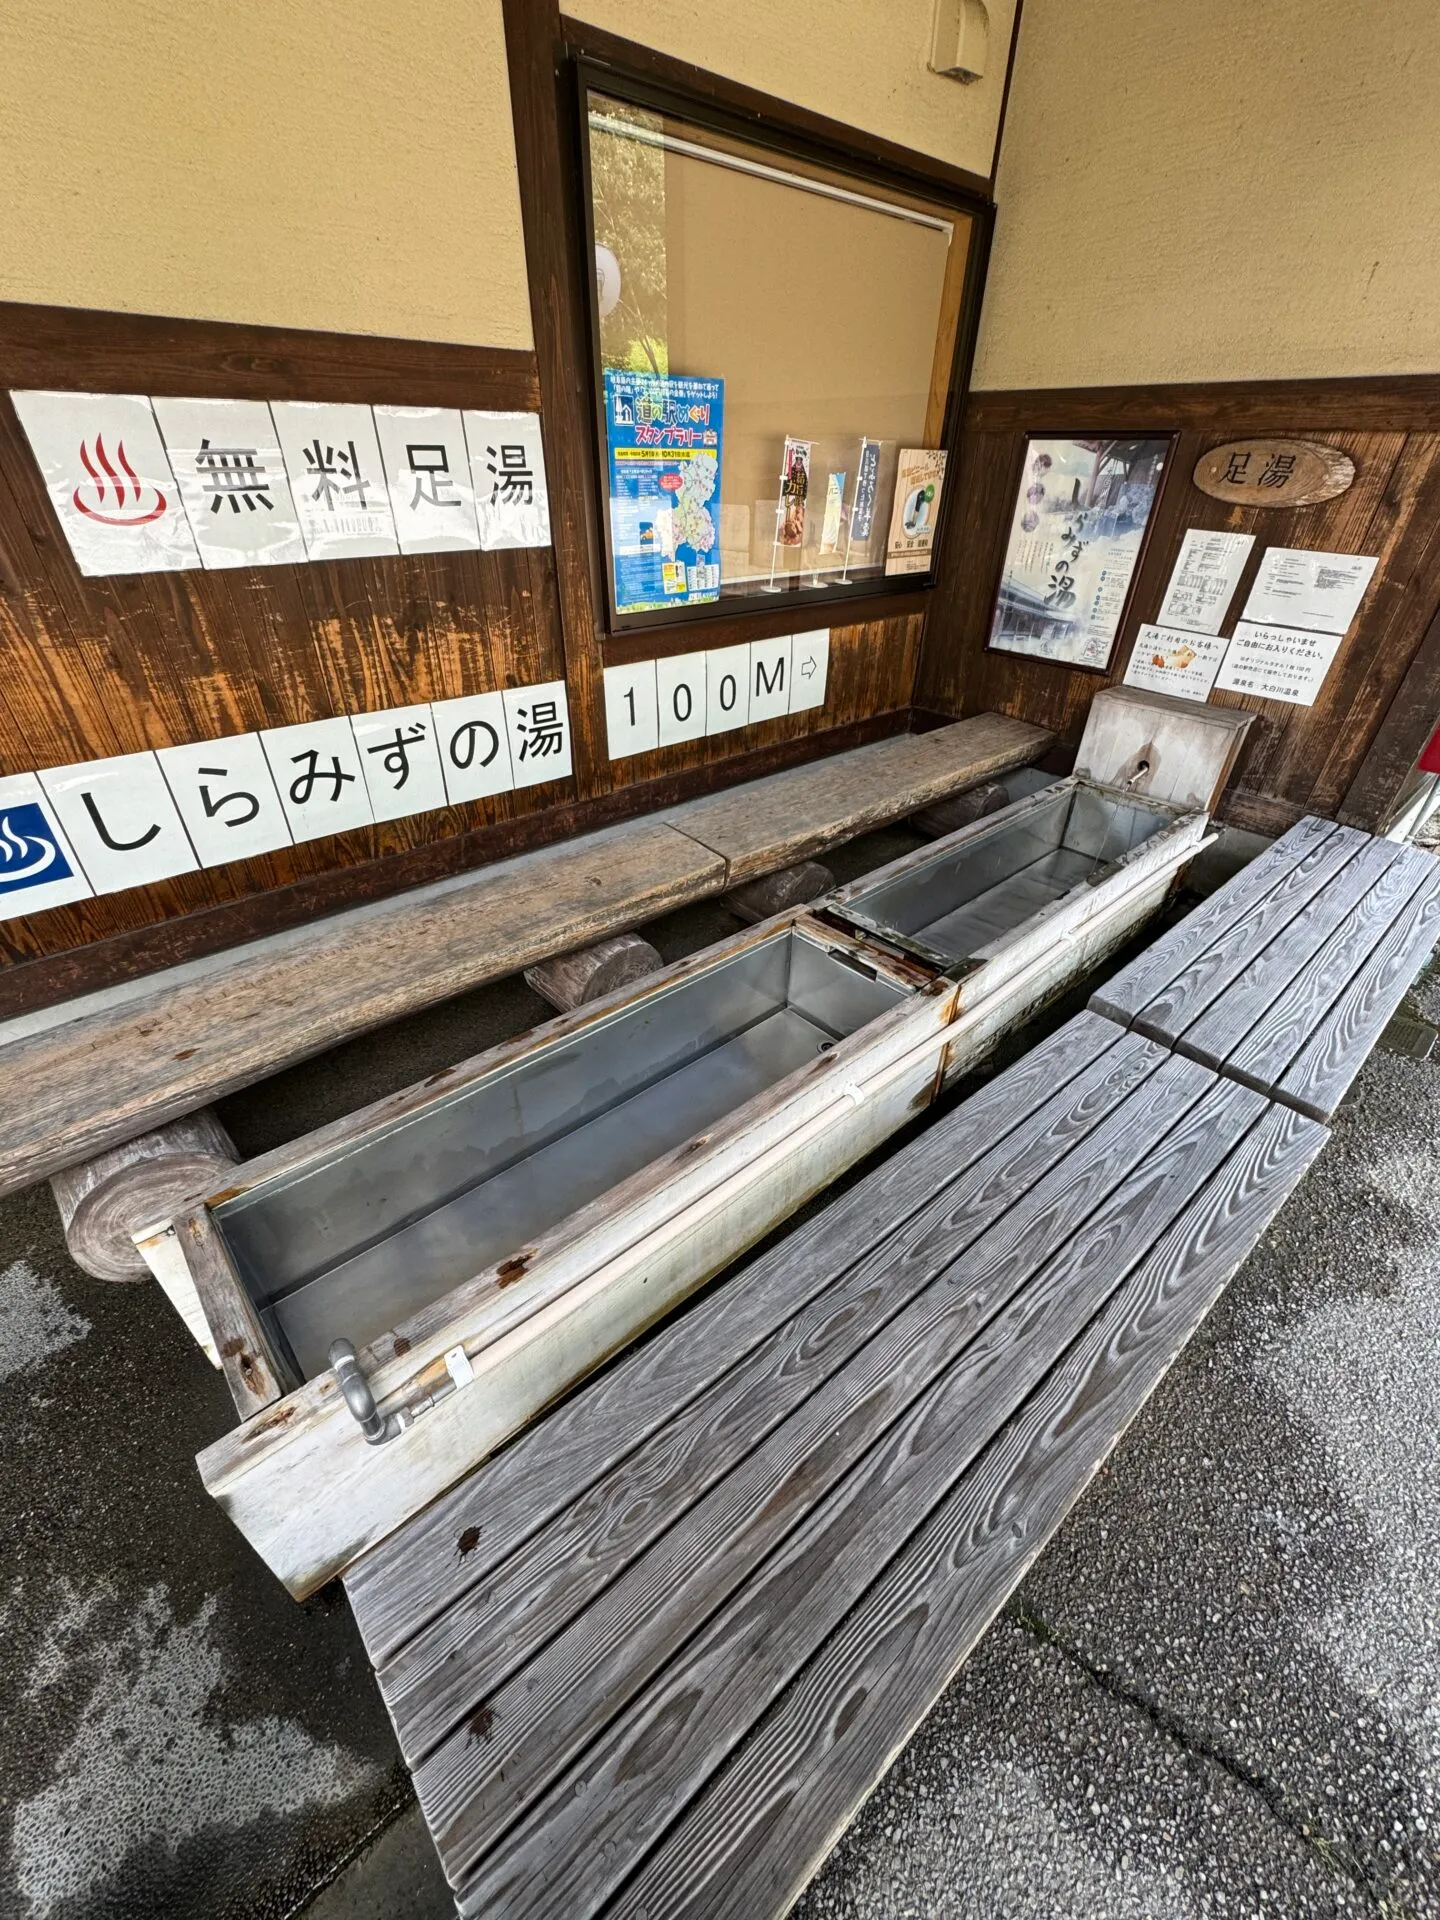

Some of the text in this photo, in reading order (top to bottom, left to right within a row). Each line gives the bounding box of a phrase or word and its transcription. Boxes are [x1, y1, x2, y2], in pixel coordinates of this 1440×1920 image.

[636, 397, 711, 426] 道の駅めぐり
[635, 425, 702, 448] スタンプラリー
[194, 438, 534, 515] 無料足湯
[1219, 450, 1297, 489] 足湯
[1144, 630, 1219, 650] 足湯ご利用のお客様へ
[1236, 638, 1324, 660] ご自由にお入りください。
[1254, 630, 1317, 647] いらっしゃいませ
[622, 656, 786, 728] 100M
[80, 700, 565, 852] しらみずの湯
